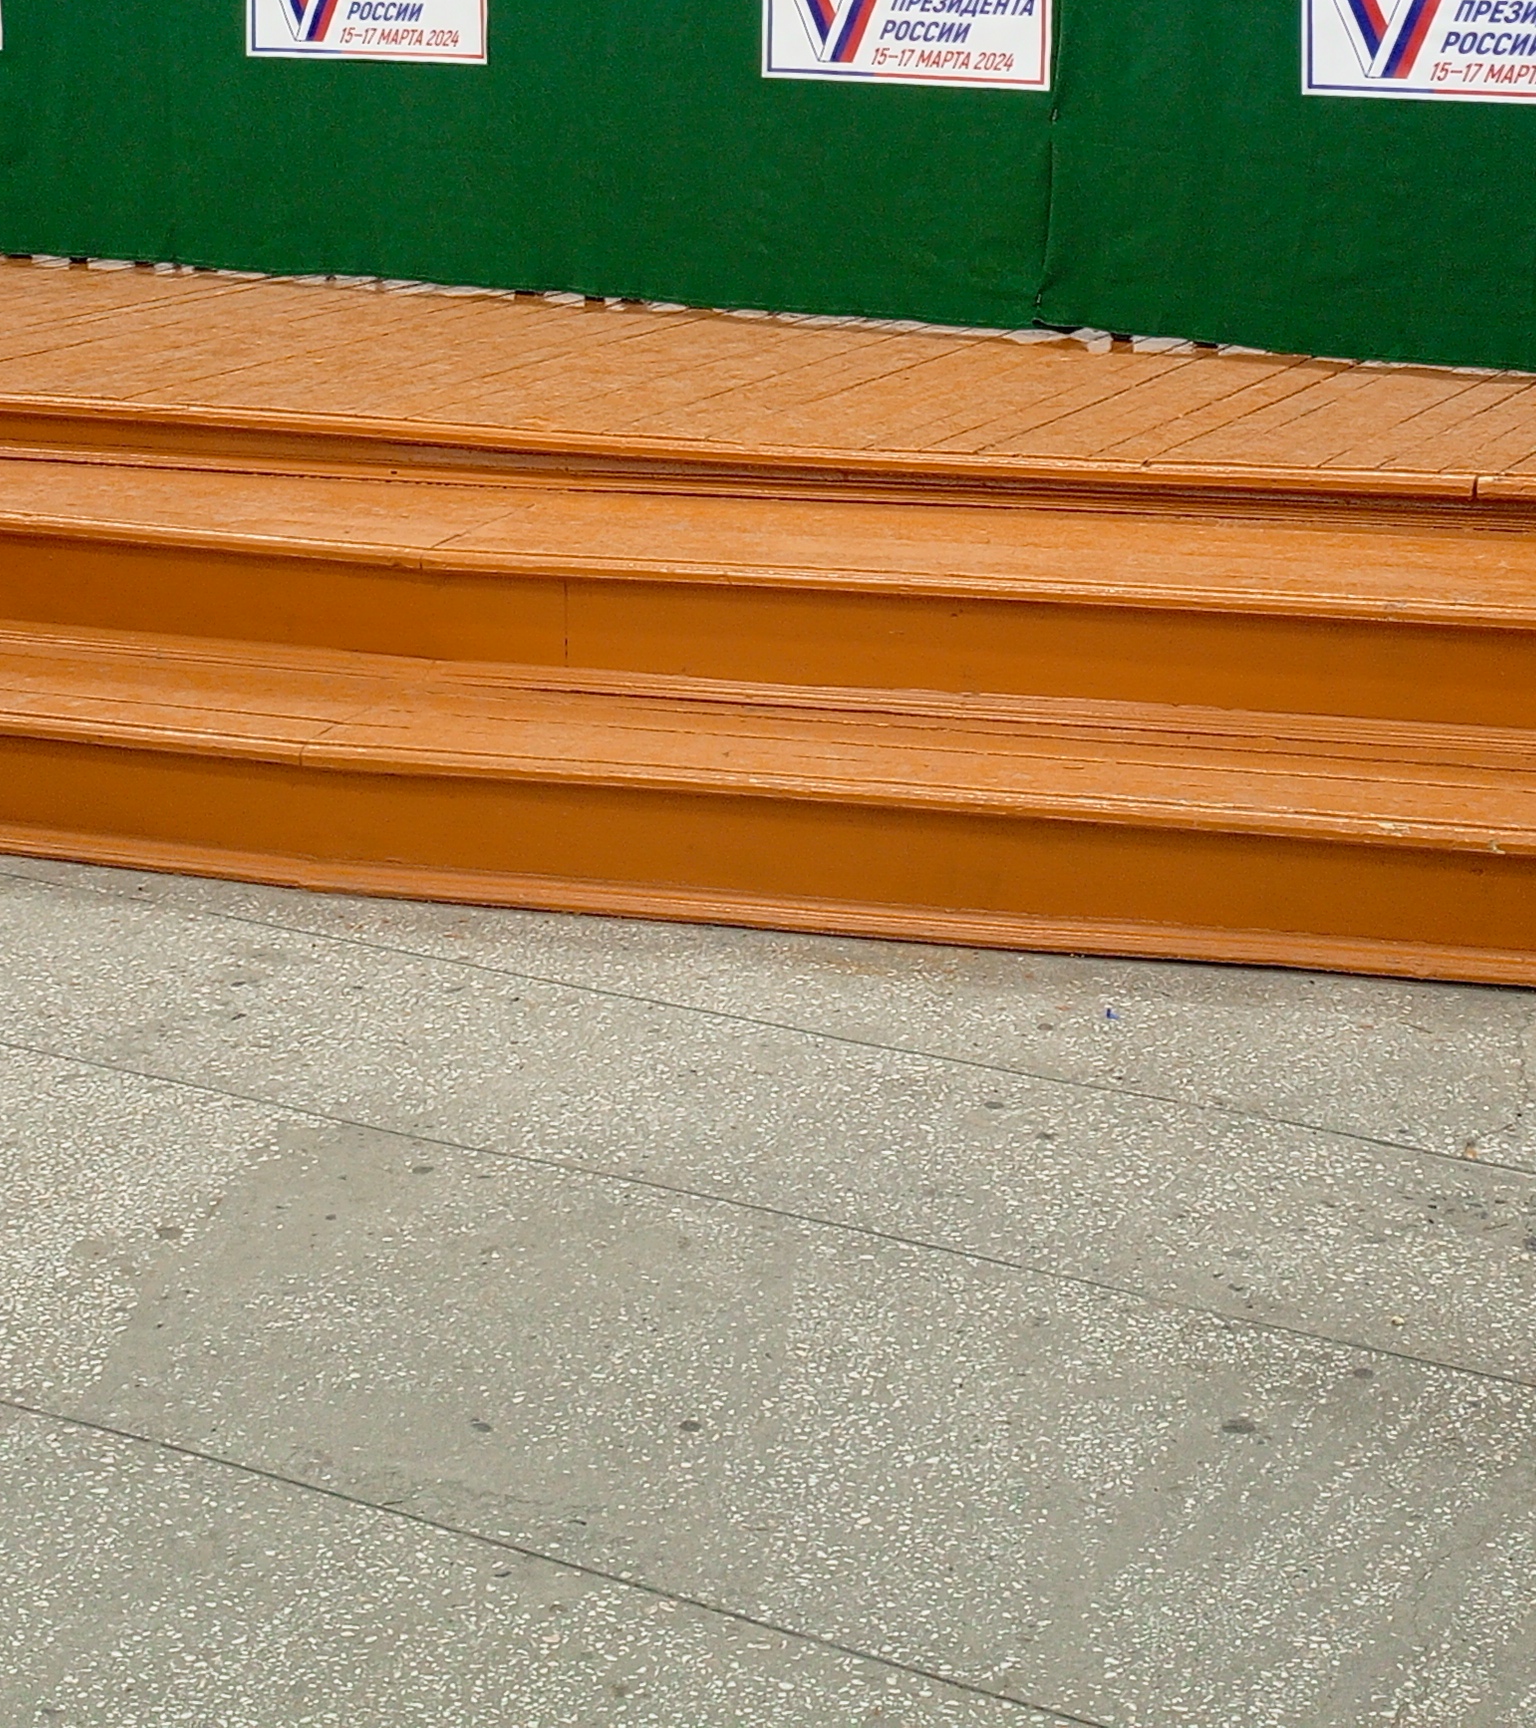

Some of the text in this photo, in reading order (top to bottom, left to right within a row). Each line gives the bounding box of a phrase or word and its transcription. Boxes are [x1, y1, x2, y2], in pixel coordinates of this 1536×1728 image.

[347, 2, 423, 22] РОССИИ
[378, 29, 423, 45] МАРТА
[426, 30, 460, 47] 2024
[880, 20, 971, 43] РОССИИ
[916, 49, 969, 70] МАРТА
[973, 52, 1014, 71] 2024
